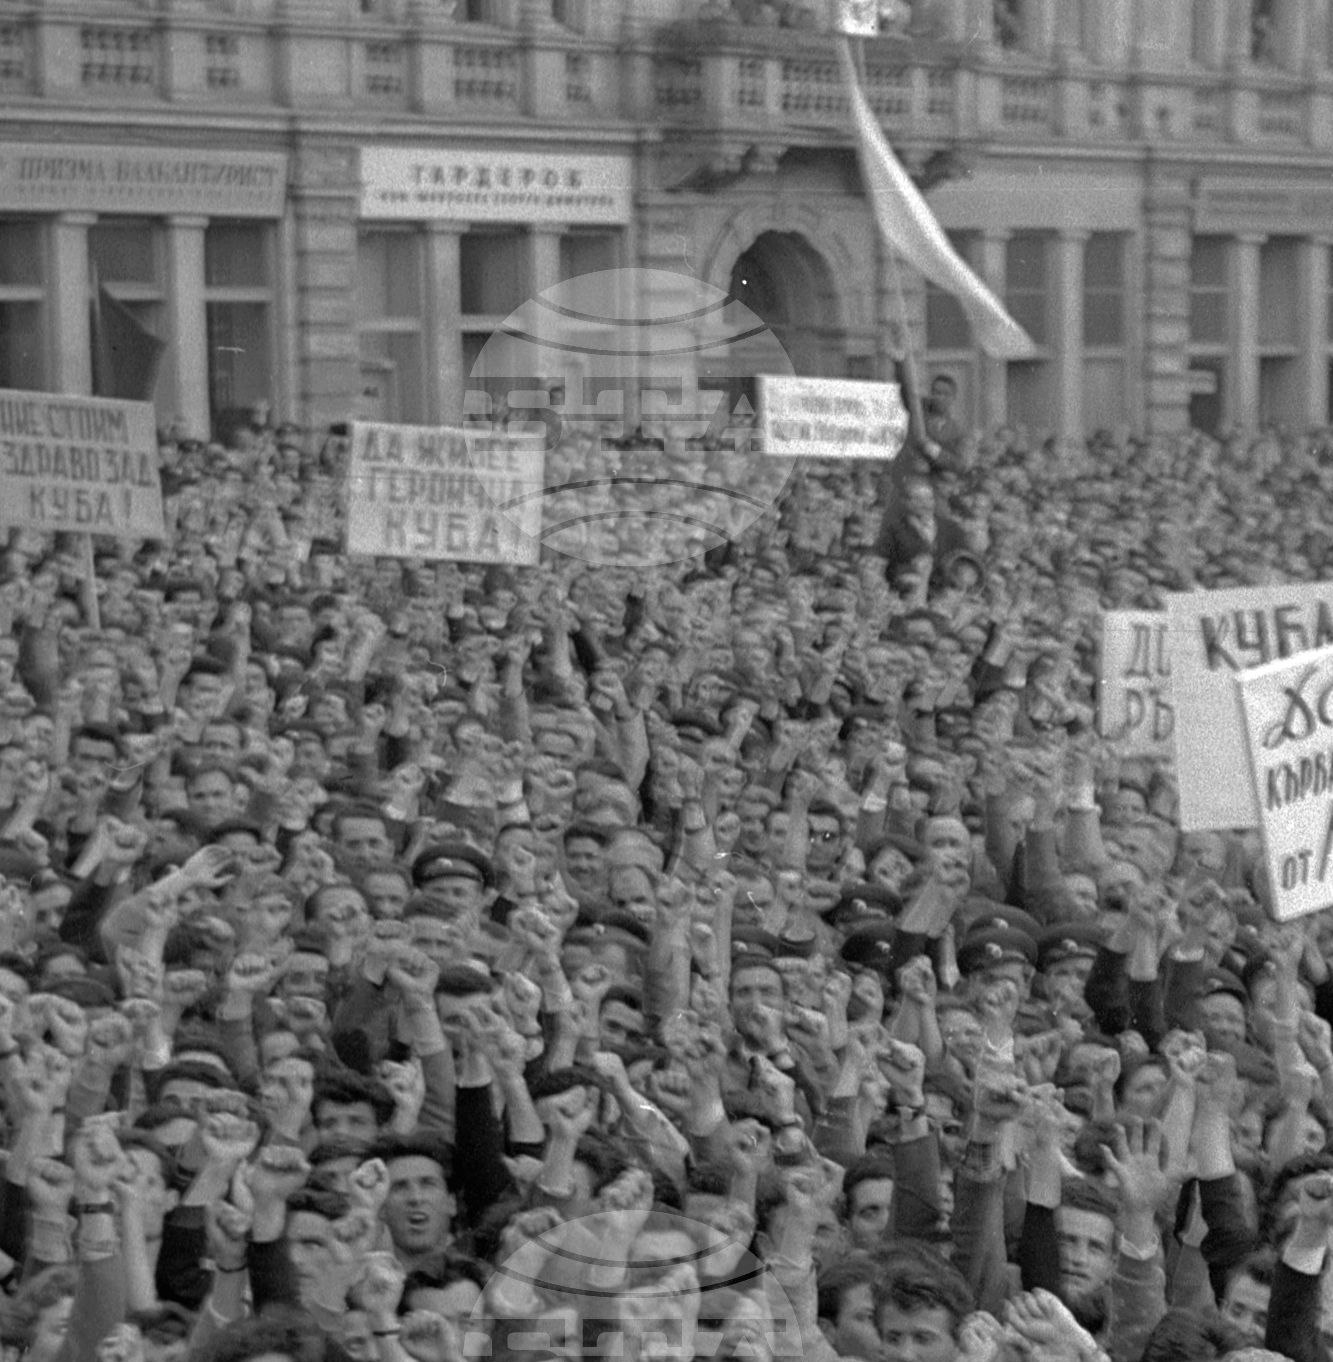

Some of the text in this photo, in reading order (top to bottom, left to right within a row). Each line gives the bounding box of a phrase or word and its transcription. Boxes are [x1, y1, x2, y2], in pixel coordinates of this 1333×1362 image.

[409, 164, 583, 191] ГАРДЕРОБ
[48, 403, 129, 444] СТОИМ
[3, 441, 156, 488] ЗДРАВО ЗАД
[28, 484, 132, 528] КУБА!
